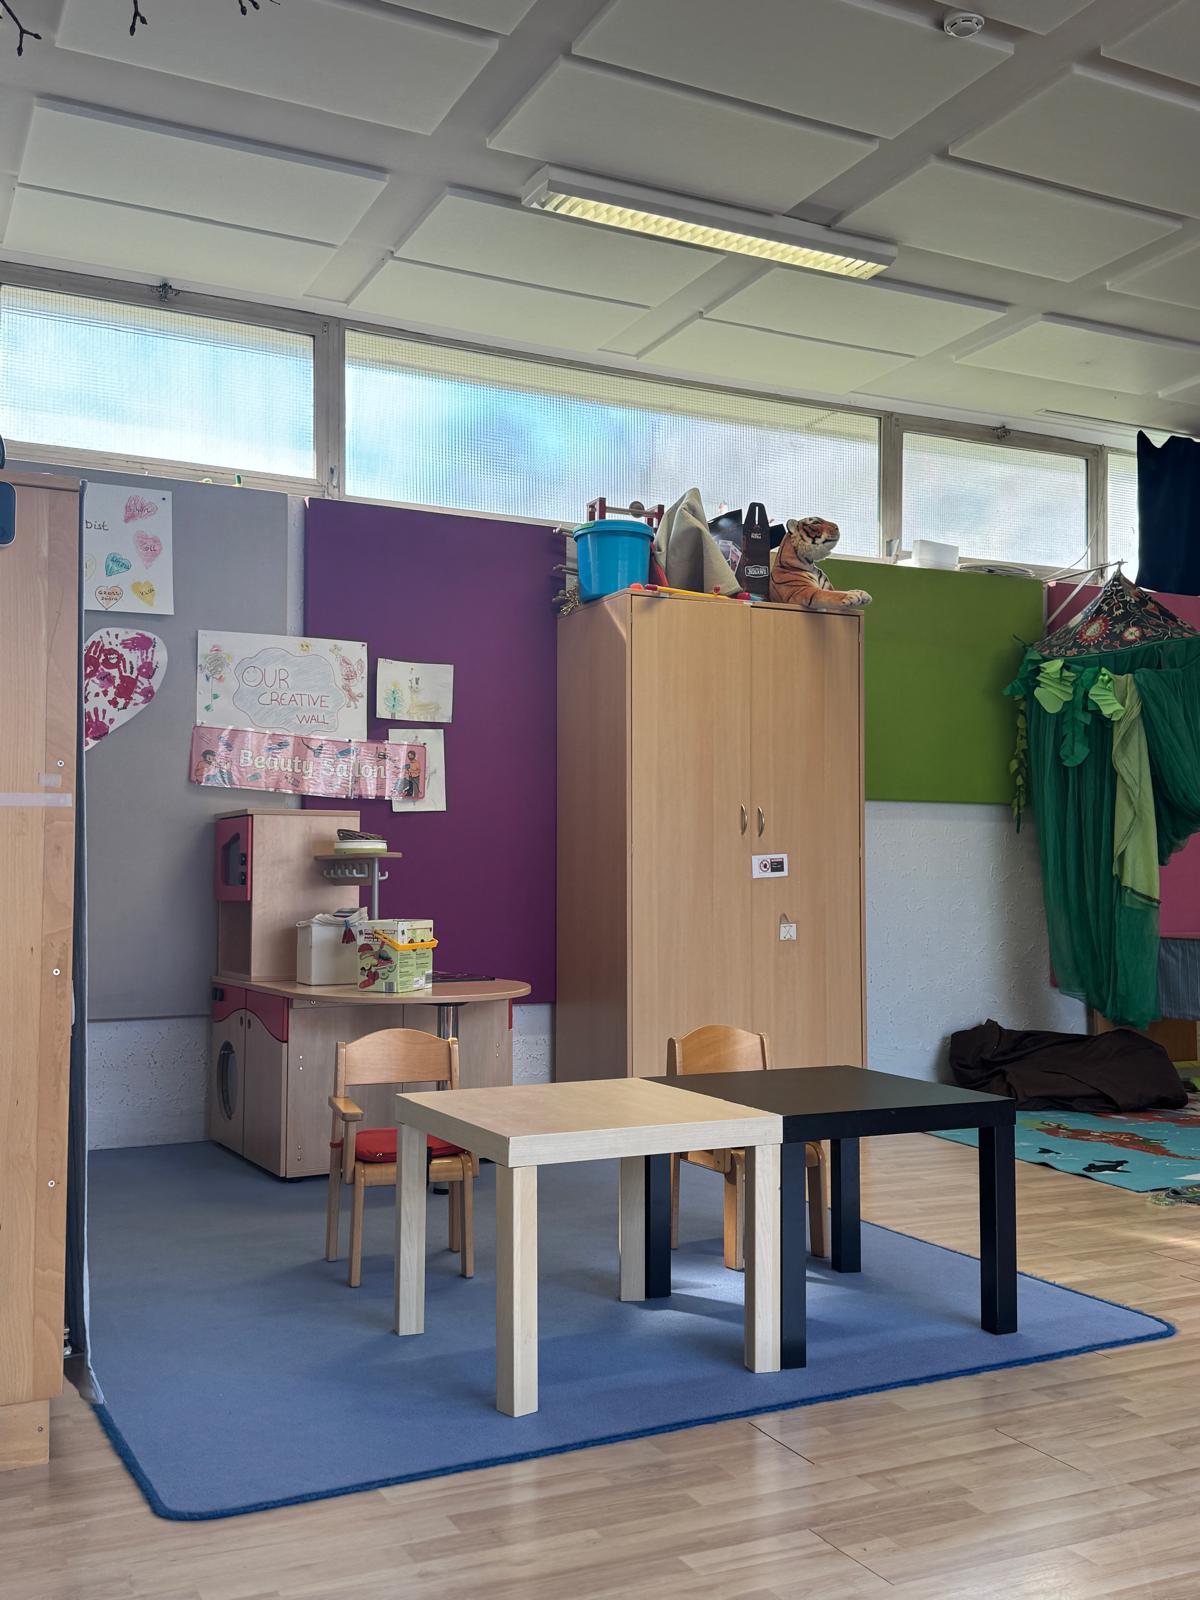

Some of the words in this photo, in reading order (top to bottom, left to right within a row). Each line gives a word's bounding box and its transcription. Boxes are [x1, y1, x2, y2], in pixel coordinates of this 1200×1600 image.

[242, 665, 290, 689] OUR
[257, 692, 330, 708] CREATIVE
[296, 714, 329, 725] WALL
[239, 749, 314, 779] Beauty
[323, 757, 386, 779] Salon
